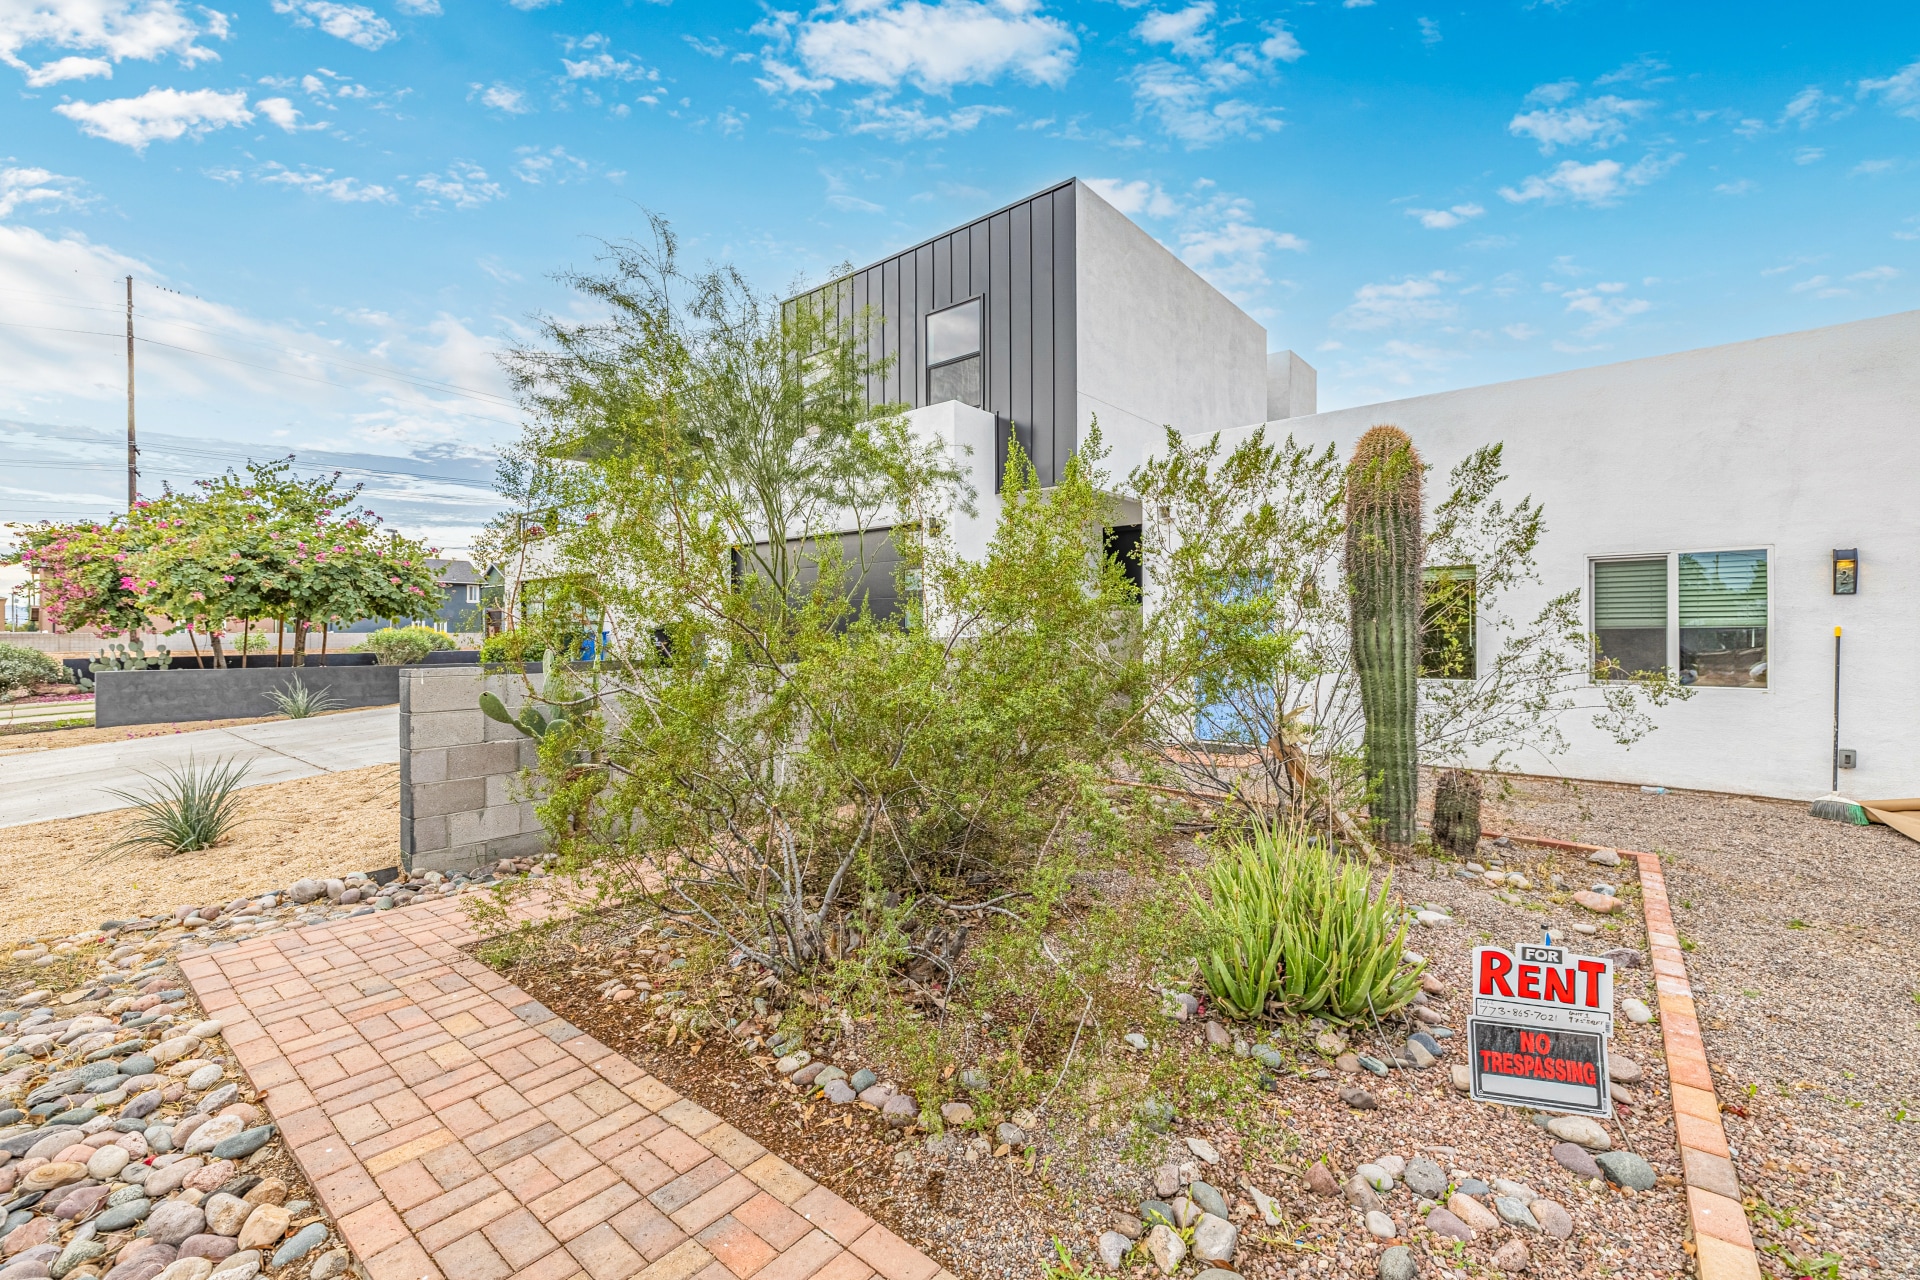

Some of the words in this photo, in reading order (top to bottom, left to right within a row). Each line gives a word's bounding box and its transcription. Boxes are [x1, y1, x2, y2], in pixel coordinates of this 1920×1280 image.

[1840, 570, 1849, 585] 2
[1524, 948, 1559, 963] FOR
[1479, 950, 1607, 1008] RENT
[1480, 1004, 1558, 1021] 773-865-7021
[1519, 1031, 1551, 1055] NO
[1479, 1050, 1597, 1085] TRESPASSING
